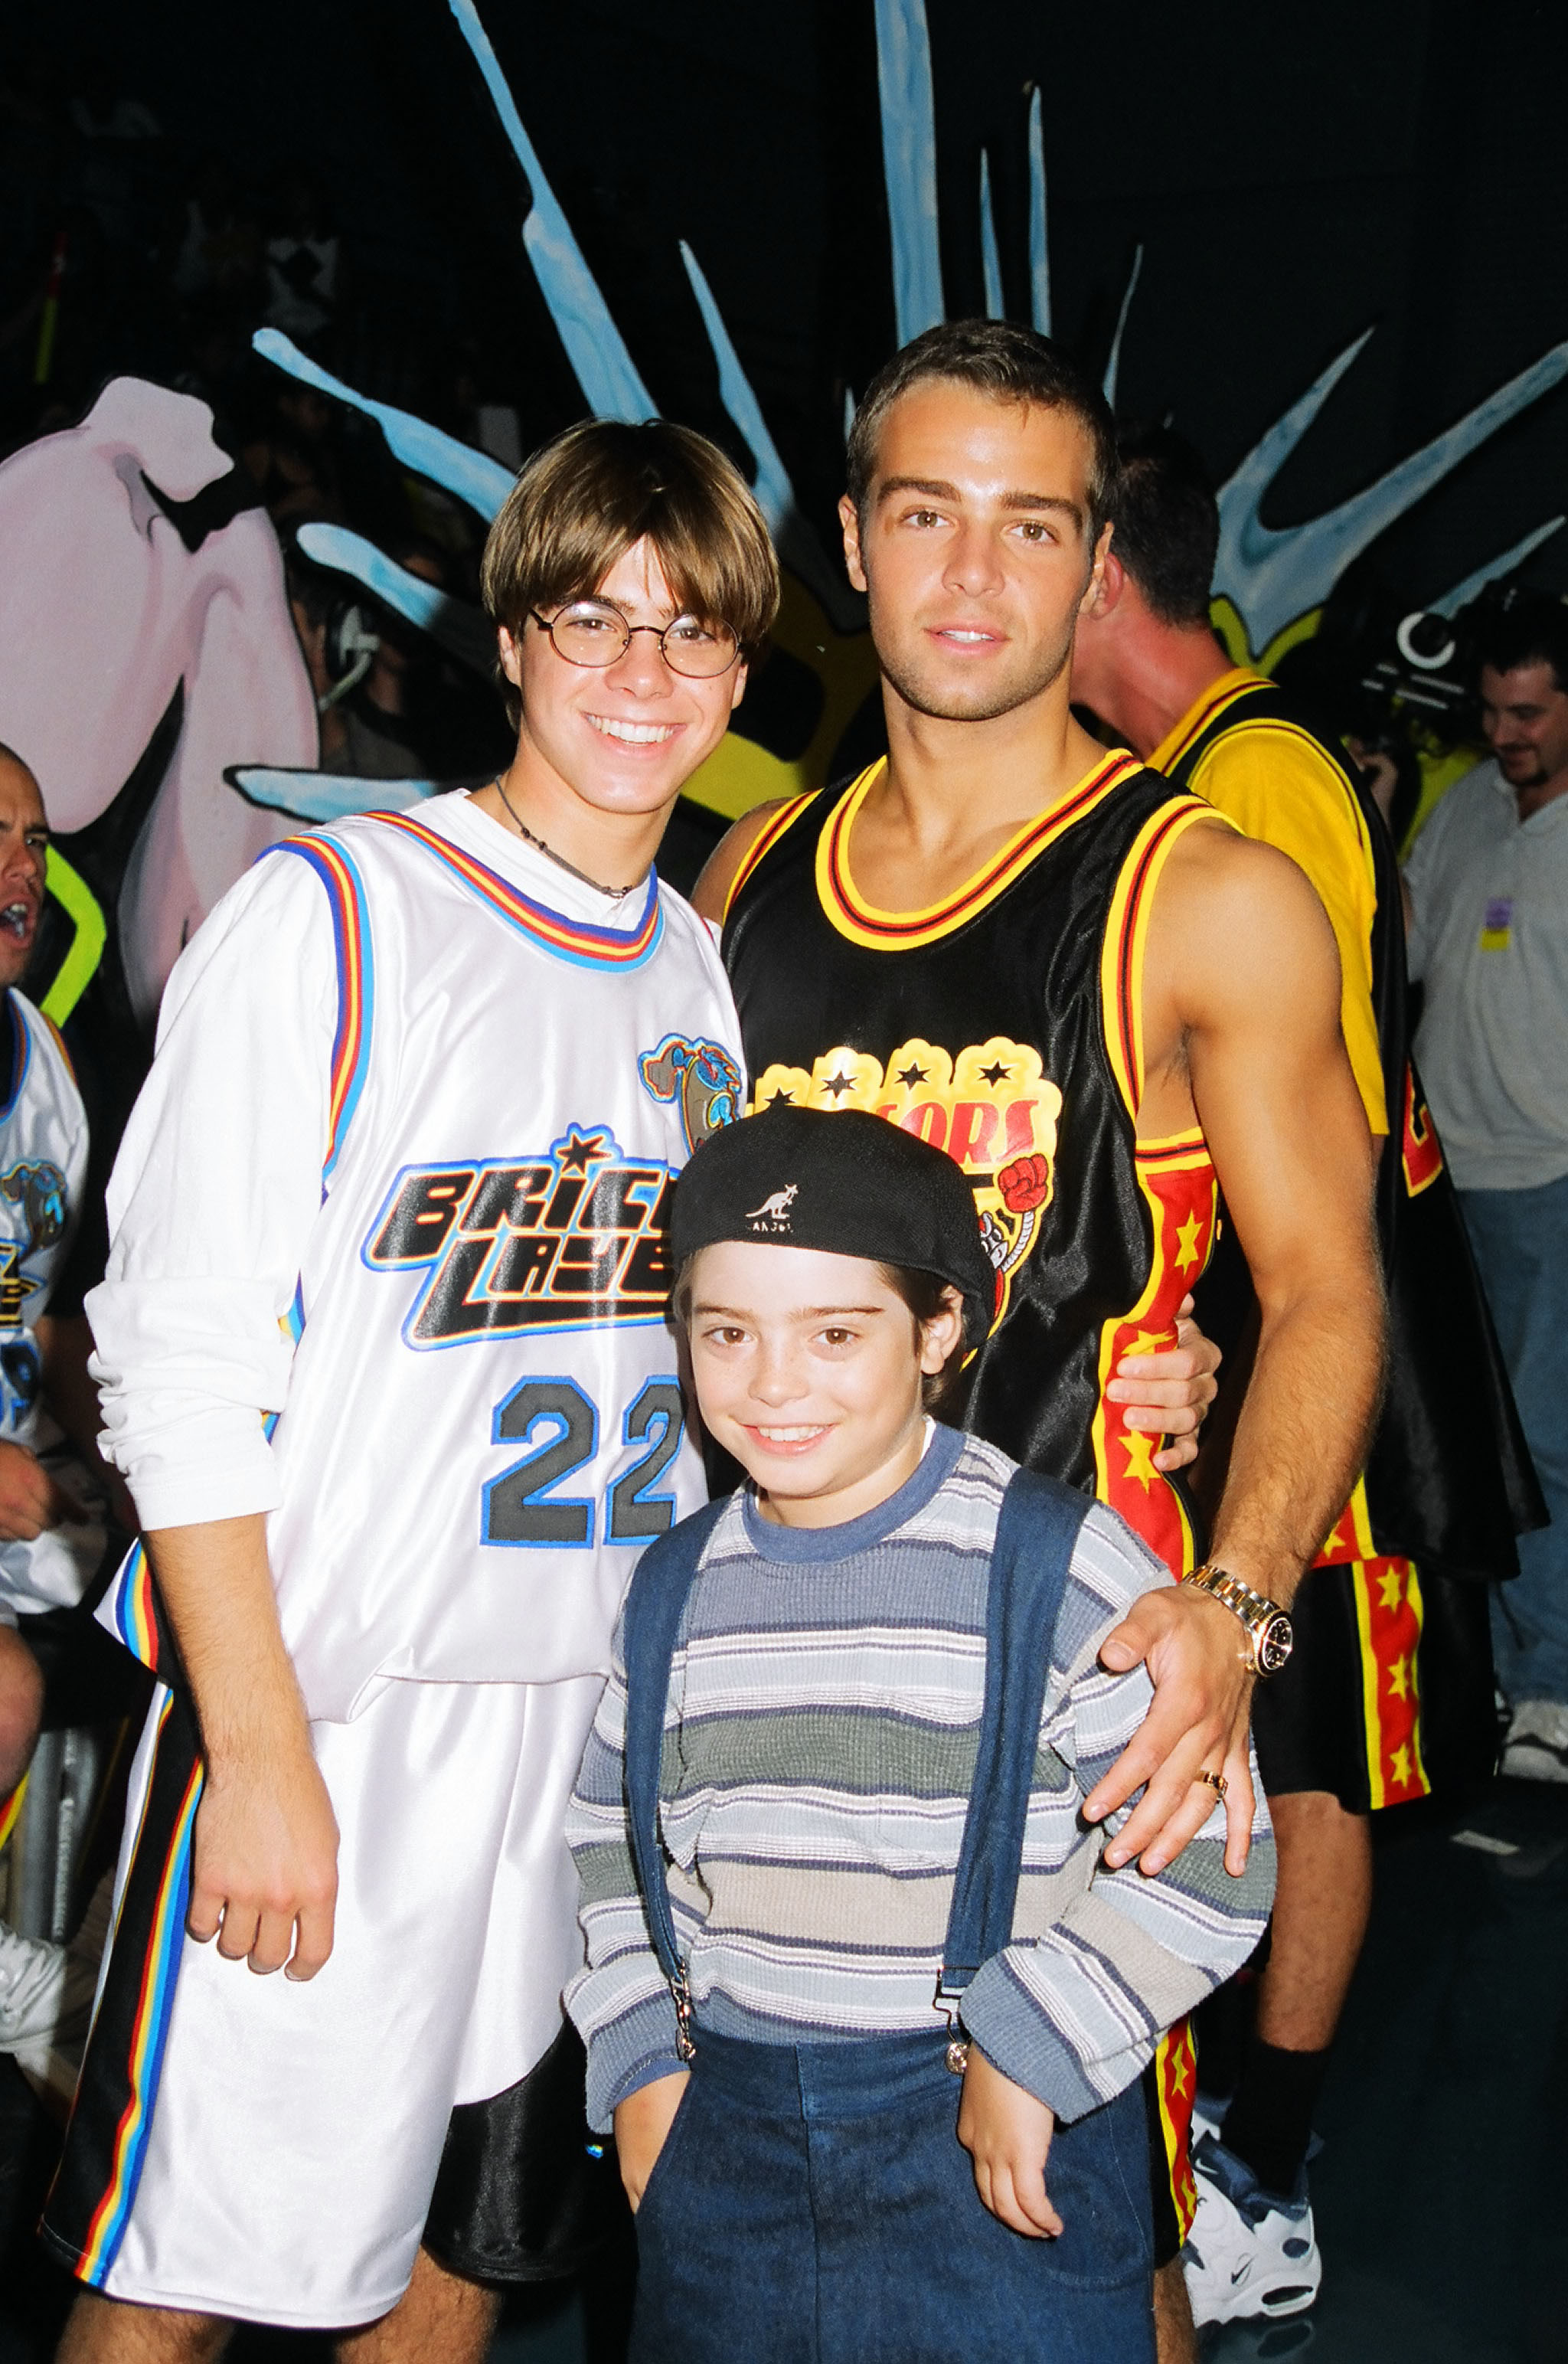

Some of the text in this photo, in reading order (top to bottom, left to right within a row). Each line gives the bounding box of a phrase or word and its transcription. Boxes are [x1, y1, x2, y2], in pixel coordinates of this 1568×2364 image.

[875, 1100, 1040, 1164] ORS
[411, 1233, 671, 1341] LAYE
[479, 1375, 687, 1549] 22
